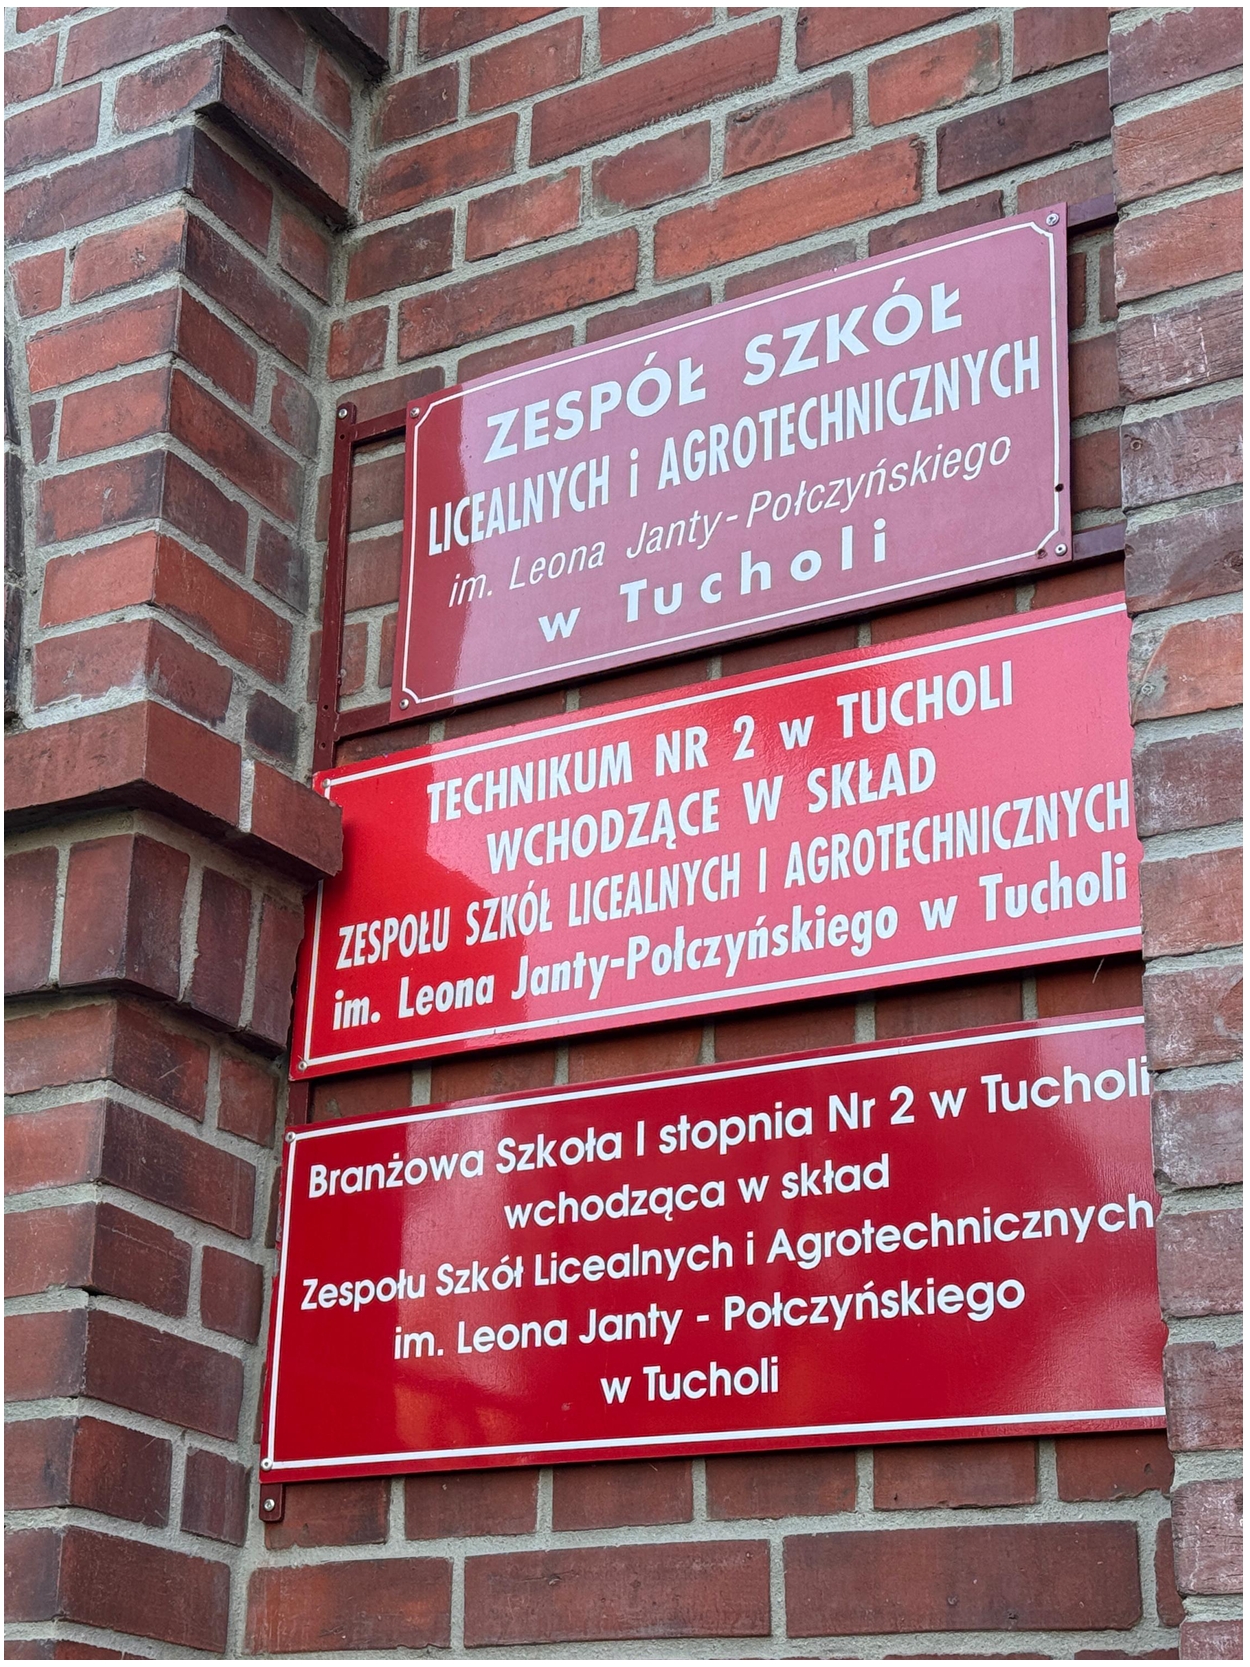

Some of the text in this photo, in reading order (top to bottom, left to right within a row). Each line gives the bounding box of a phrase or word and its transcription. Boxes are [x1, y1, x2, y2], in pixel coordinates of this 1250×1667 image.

[484, 281, 963, 464] ZESPÓŁ SZKÓŁ
[428, 335, 1041, 557] LICEALNYCH i AGROTECHNICZNYCH
[448, 572, 494, 608] im.
[508, 543, 606, 591] Leona
[536, 517, 887, 643] w Tucholi
[426, 660, 1013, 824] TECHNIKUM NR 2 w TUCHOLI
[336, 778, 1130, 969] ZESPOŁU SZKÓŁ LICEALNYCH I AGROTECHNICZNYCH
[485, 747, 937, 875] WCHODZĄCE W SKŁAD
[333, 850, 1127, 1030] im. Leona Janty-Połczyńskiego w Tucholi
[309, 1055, 1151, 1198] Branżowa Szkoła I stopnia Nr 2 w Tucholi
[301, 1193, 1154, 1312] Zespołu Szkół Licealnych i Agrotechnicznych
[503, 1153, 890, 1229] wchodząca w skład
[394, 1326, 444, 1359] im.
[457, 1319, 568, 1354] Leona
[579, 1303, 683, 1345] Janty
[724, 1277, 1025, 1331] Połczyńskiego
[600, 1356, 779, 1404] w Tucholi
